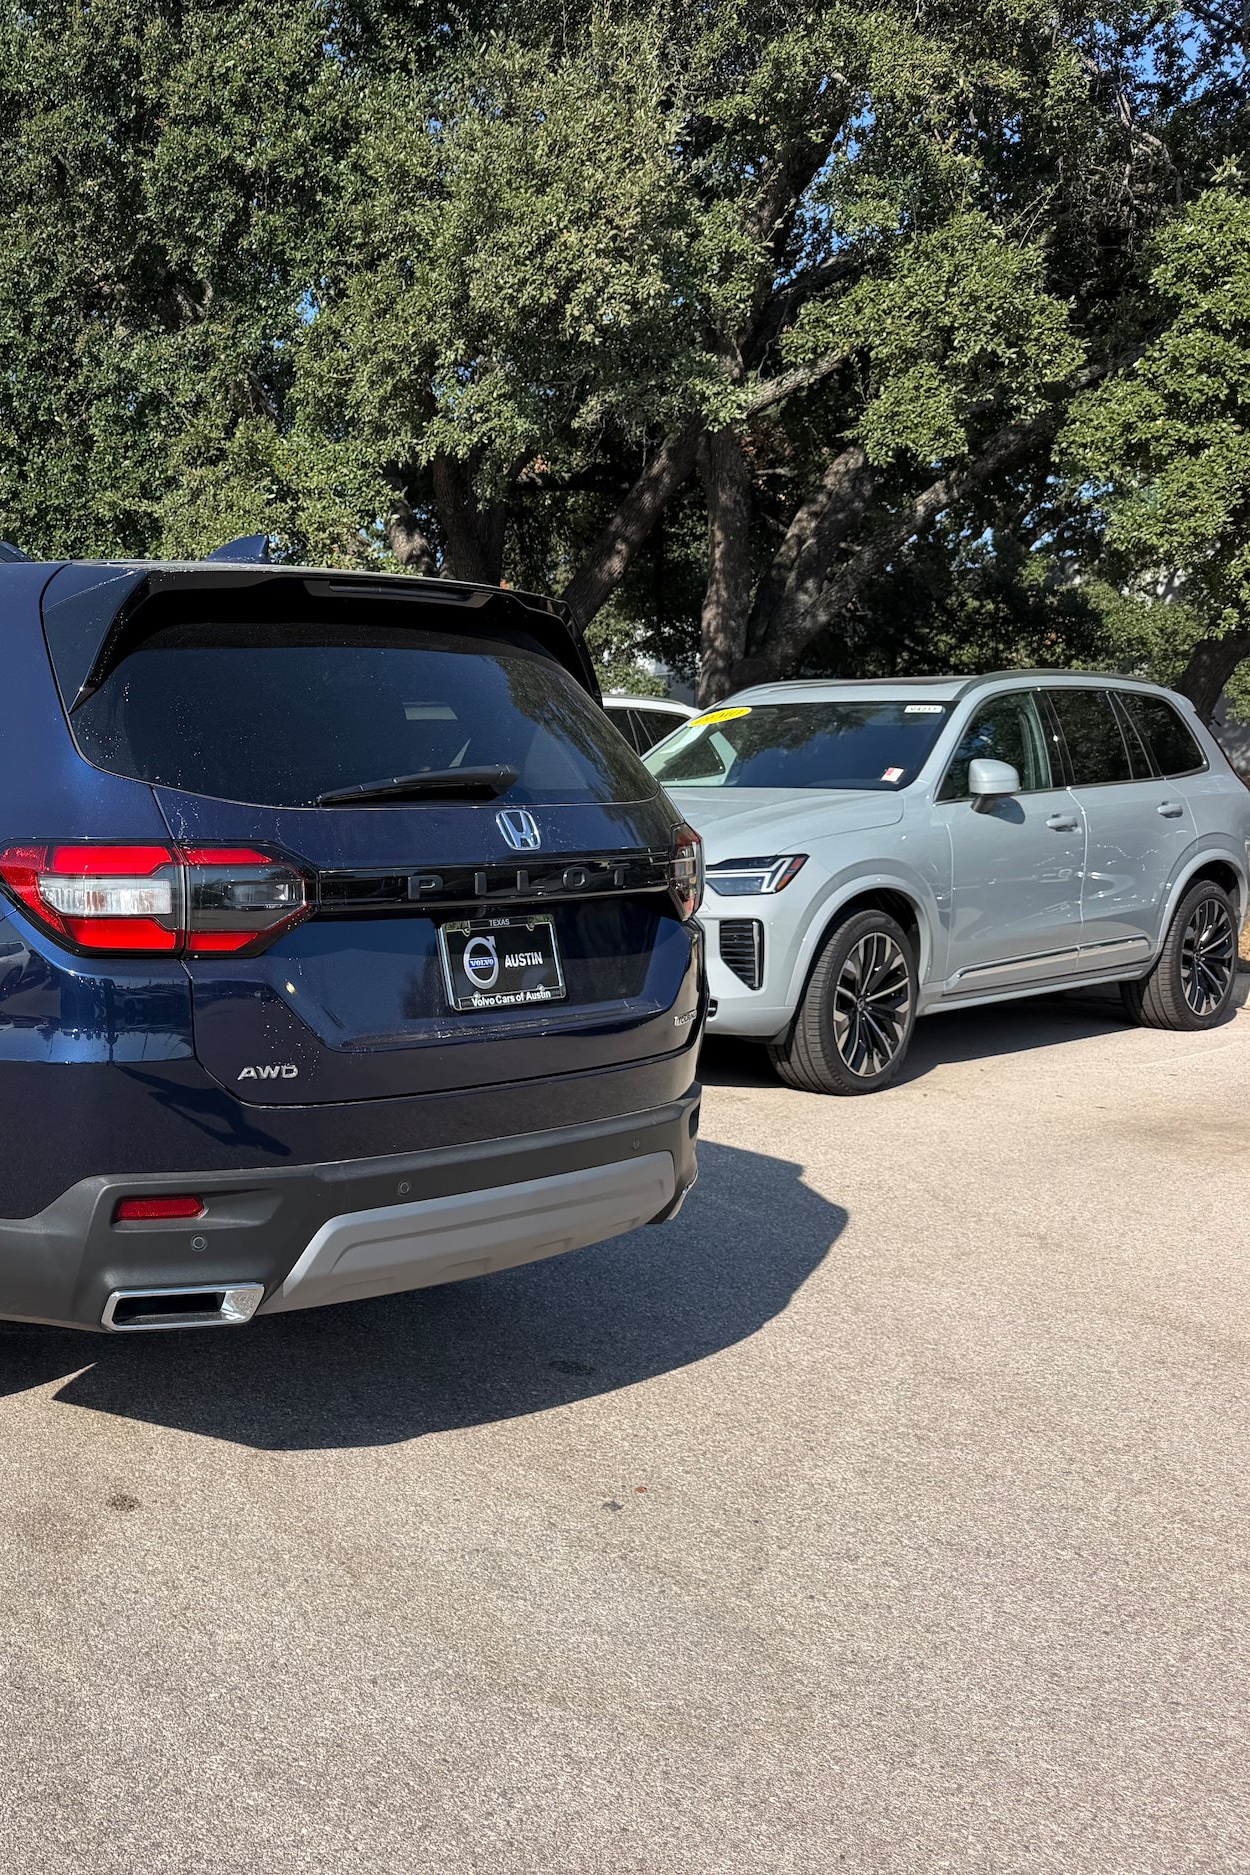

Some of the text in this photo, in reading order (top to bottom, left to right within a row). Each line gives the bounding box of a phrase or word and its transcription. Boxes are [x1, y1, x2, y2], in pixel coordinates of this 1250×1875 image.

[407, 863, 631, 900] PILOT
[489, 918, 510, 927] TEXAS
[469, 957, 495, 967] VOLVO
[504, 951, 544, 968] AUSTIN
[471, 995, 495, 1007] Volvo
[495, 993, 515, 1004] Cars
[516, 992, 525, 1002] of
[526, 990, 551, 1001] Austin
[237, 1064, 299, 1080] AWD
